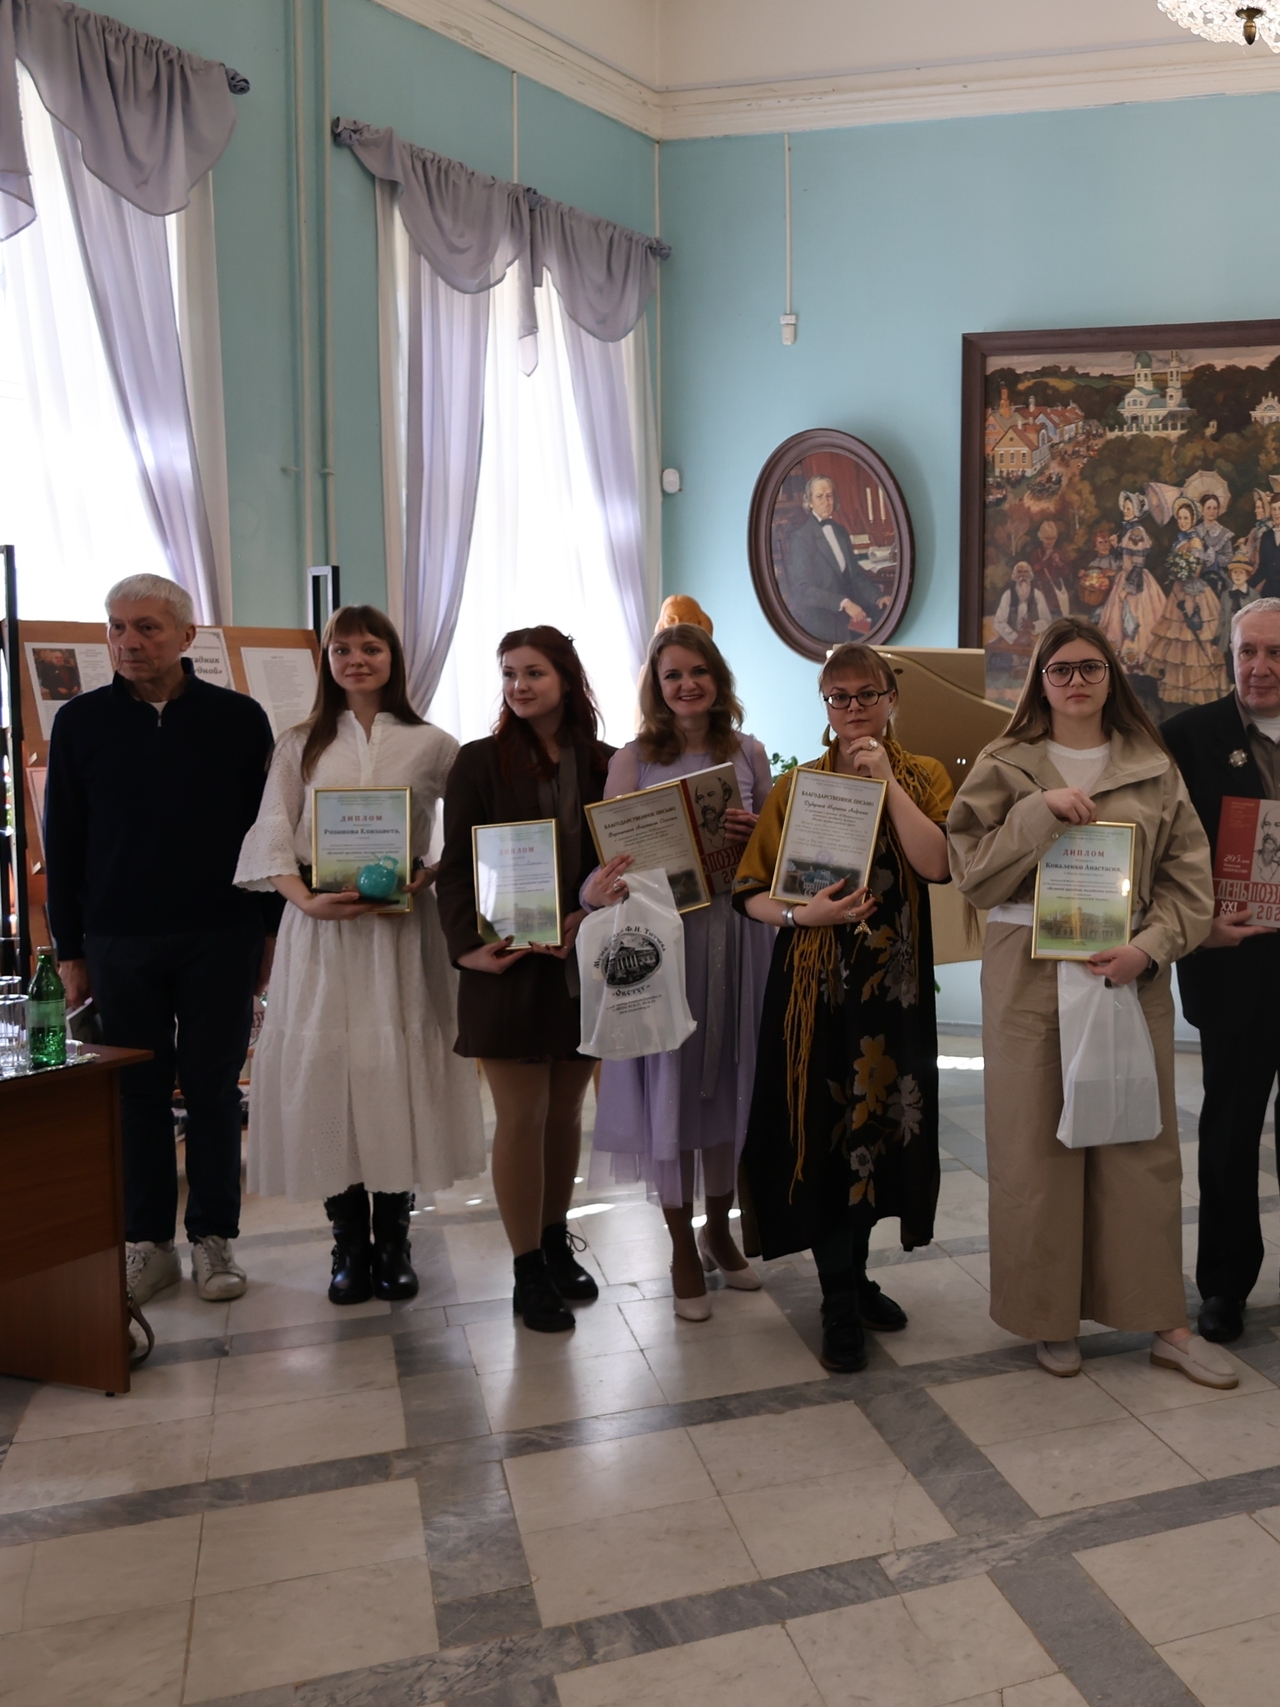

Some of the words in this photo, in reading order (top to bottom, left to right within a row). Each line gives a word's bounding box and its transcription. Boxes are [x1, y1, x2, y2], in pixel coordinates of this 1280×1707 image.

[1063, 849, 1105, 858] ДИПЛОМ
[1045, 862, 1084, 870] Коваленко
[1220, 901, 1238, 912] XXI
